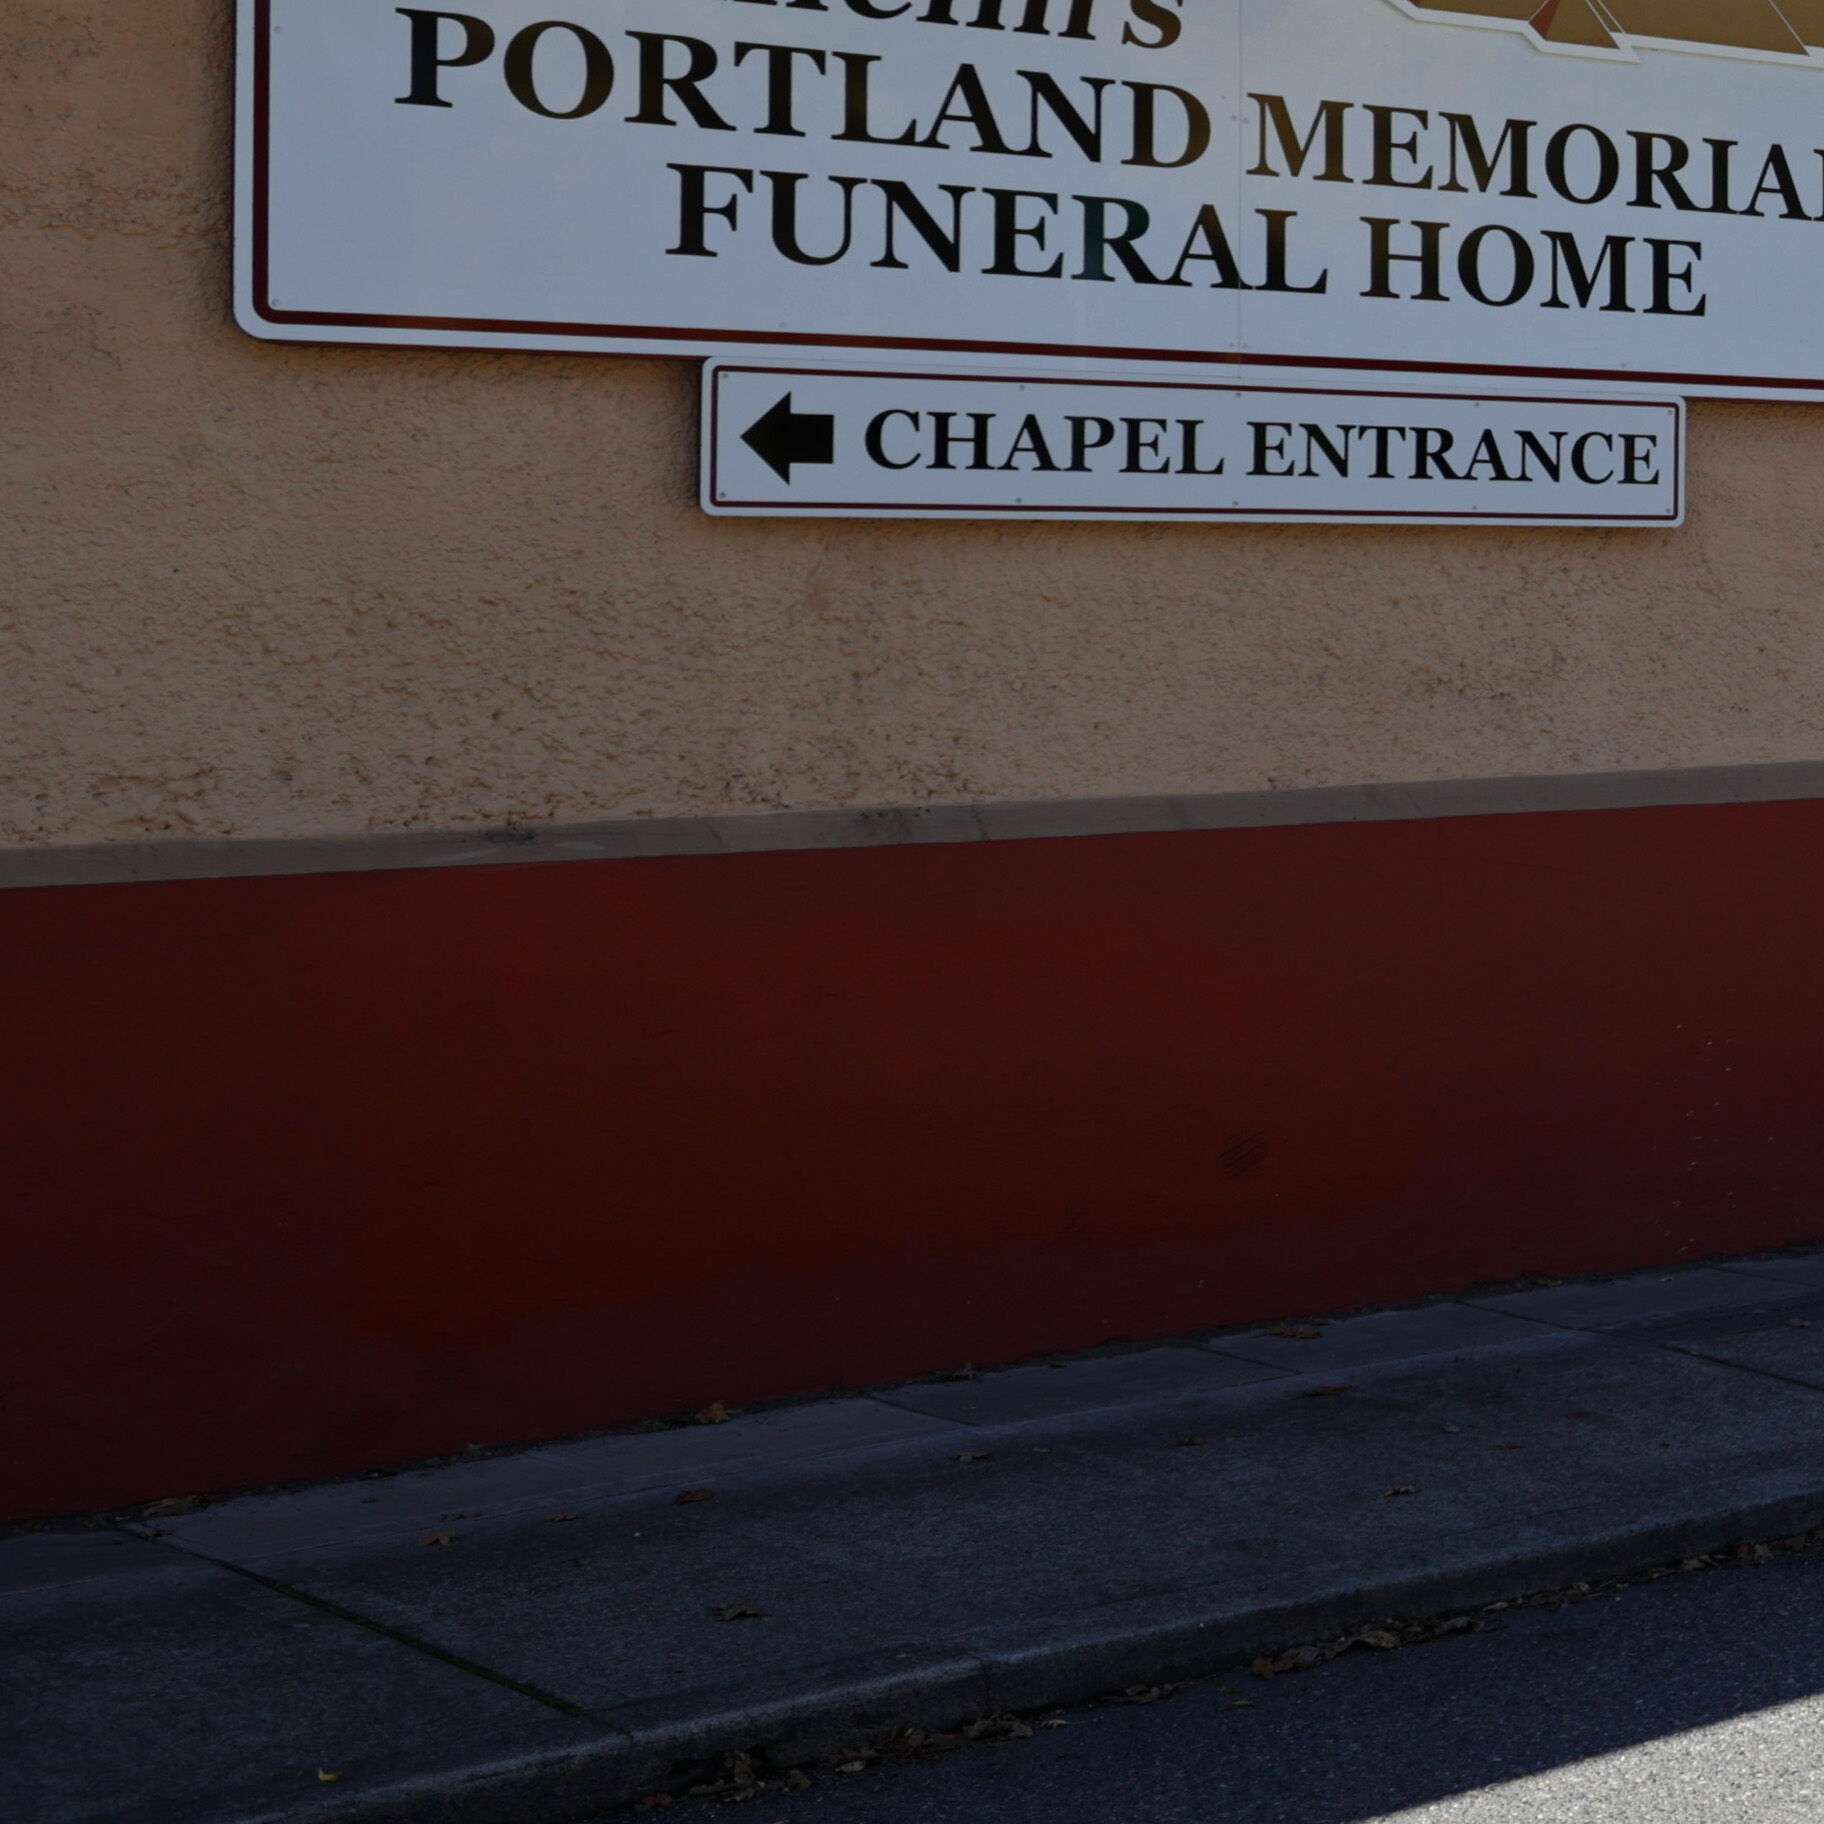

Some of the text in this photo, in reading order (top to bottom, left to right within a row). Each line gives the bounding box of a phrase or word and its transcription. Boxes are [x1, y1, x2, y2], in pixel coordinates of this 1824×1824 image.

[395, 8, 1212, 168] PORTLAND
[666, 163, 1707, 317] FUNERAL HOME
[864, 408, 1660, 485] CHAPEL ENTRANCE
